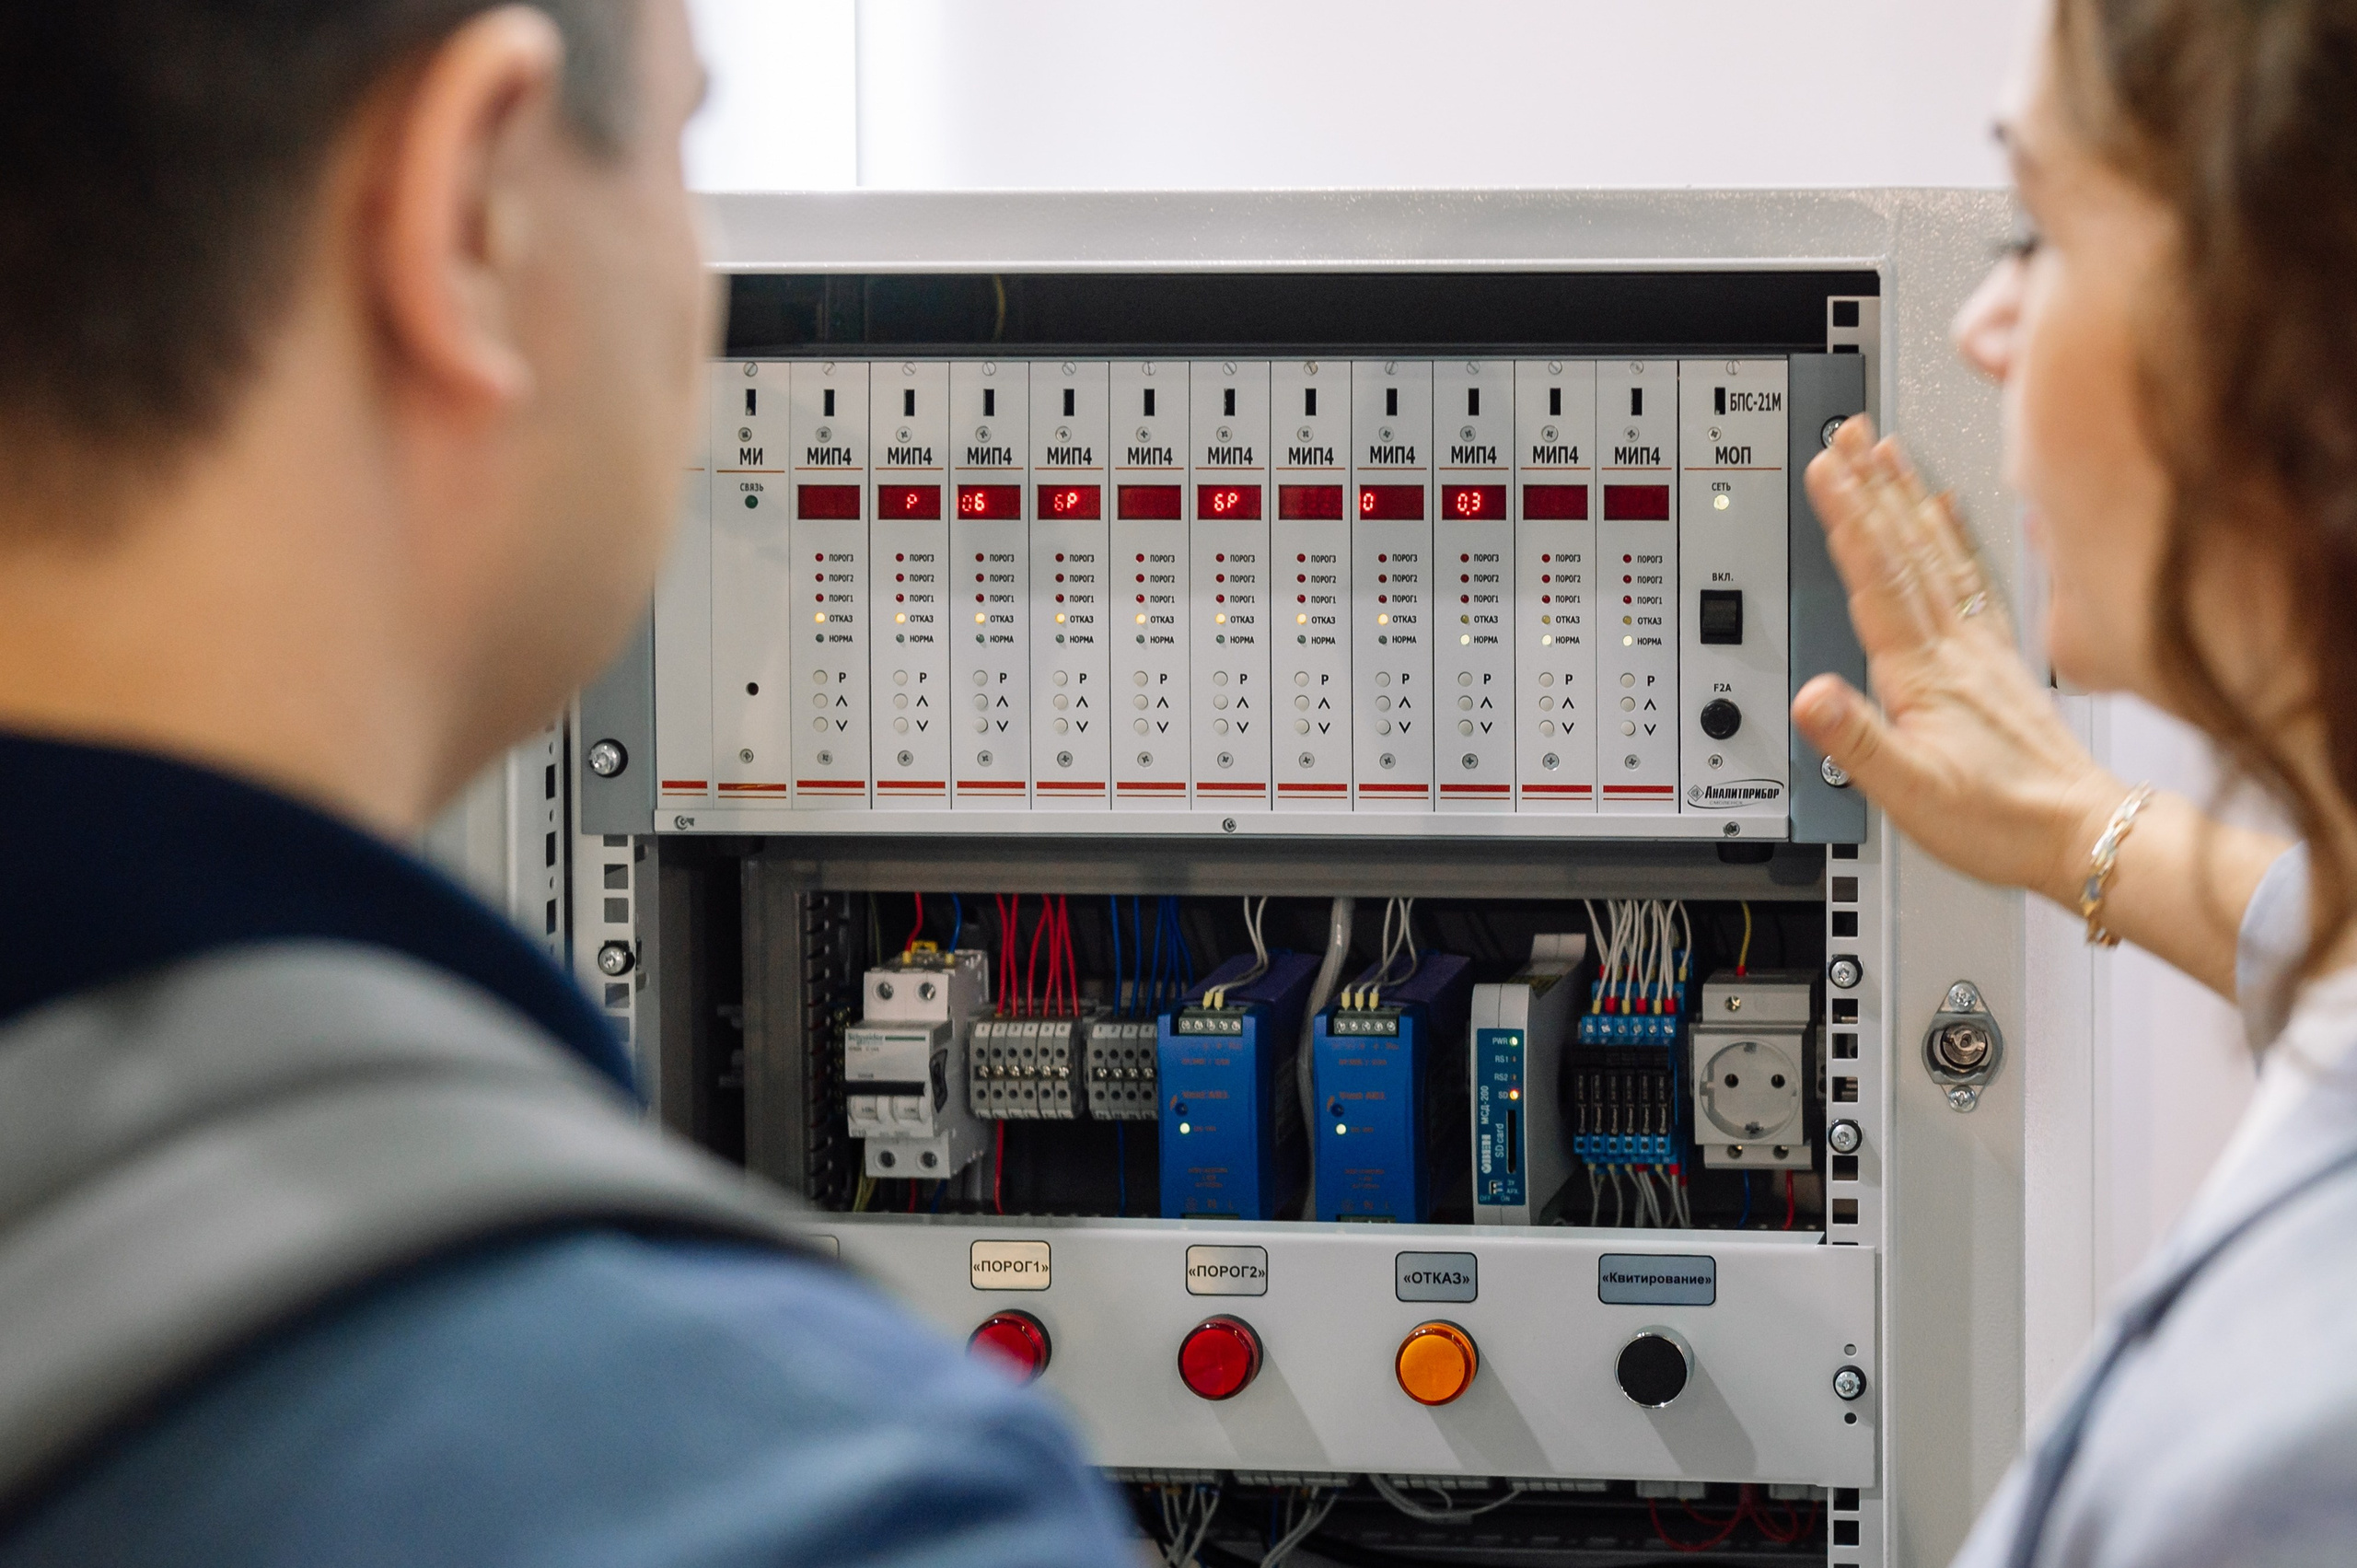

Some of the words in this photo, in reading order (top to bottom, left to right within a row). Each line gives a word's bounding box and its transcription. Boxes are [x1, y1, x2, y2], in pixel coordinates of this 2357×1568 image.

[1729, 391, 1782, 412] БПС-21М
[739, 447, 763, 466] МИ
[807, 447, 853, 466] МИП4
[887, 447, 933, 466] МИП4
[967, 447, 1013, 466] МИП4
[1047, 446, 1093, 466] МИП4
[1127, 447, 1173, 466] МИП4
[1207, 446, 1254, 466] МИП4
[1288, 447, 1335, 466] МИП4
[1369, 445, 1416, 465] МИП4
[1450, 445, 1498, 465] МИП4
[1532, 445, 1579, 465] МИП4
[1614, 446, 1661, 466] МИП4
[1715, 446, 1752, 465] МОП
[739, 482, 764, 493] СВЯЗЬ
[1711, 482, 1732, 492] СЕТЬ
[829, 553, 854, 563] ПОРОГ3
[909, 553, 935, 563] ПОРОГ3
[989, 553, 1015, 563] ПОРОГ3
[1069, 553, 1095, 563] ПОРОГ3
[1149, 553, 1176, 563] ПОРОГ3
[1229, 553, 1256, 563] ПОРОГ3
[1310, 554, 1337, 563] ПОРОГ3
[1391, 553, 1418, 563] ПОРОГ3
[1473, 553, 1500, 563] ПОРОГ3
[1555, 553, 1582, 563] ПОРОГ3
[1637, 554, 1664, 564] ПОРОГ3
[829, 574, 854, 583] ПОРОГ2
[909, 574, 935, 583] ПОРОГ2
[989, 574, 1015, 583] ПОРОГ2
[1069, 574, 1095, 584] ПОРОГ2
[1149, 575, 1176, 584] ПОРОГ2
[1229, 574, 1256, 584] ПОРОГ2
[1310, 575, 1337, 584] ПОРОГ2
[1391, 574, 1418, 583] ПОРОГ2
[1473, 574, 1500, 583] ПОРОГ2
[1555, 574, 1582, 584] ПОРОГ2
[1637, 575, 1663, 585] ПОРОГ2
[1712, 572, 1734, 582] ВКЛ.
[829, 594, 853, 603] ПОРОГ1
[909, 594, 935, 603] ПОРОГ1
[989, 594, 1015, 603] ПОРОГ1
[1069, 594, 1095, 604] ПОРОГ1
[1149, 595, 1176, 604] ПОРОГ1
[1229, 595, 1256, 604] ПОРОГ1
[1310, 595, 1337, 605] ПОРОГ1
[1391, 594, 1418, 603] ПОРОГ1
[1473, 594, 1499, 604] ПОРОГ1
[1555, 595, 1581, 604] ПОРОГ1
[1636, 596, 1663, 605] ПОРОГ1
[829, 614, 853, 623] ОТКАЗ
[909, 614, 935, 623] ОТКАЗ
[989, 614, 1015, 623] ОТКАЗ
[1069, 614, 1095, 624] ОТКАЗ
[1150, 615, 1175, 624] ОТКАЗ
[1229, 615, 1255, 624] ОТКАЗ
[1311, 615, 1336, 625] ОТКАЗ
[1392, 614, 1417, 624] ОТКАЗ
[1473, 615, 1499, 624] ОТКАЗ
[1555, 615, 1581, 624] ОТКАЗ
[1637, 616, 1663, 626] ОТКАЗ
[829, 634, 853, 644] НОРМА
[909, 634, 935, 644] НОРМА
[989, 634, 1015, 644] НОРМА
[1069, 634, 1095, 644] НОРМА
[1150, 635, 1175, 645] НОРМА
[1229, 635, 1255, 645] НОРМА
[1311, 636, 1336, 645] НОРМА
[1391, 635, 1417, 645] НОРМА
[1473, 635, 1499, 645] НОРМА
[1555, 635, 1581, 645] НОРМА
[1637, 637, 1663, 646] НОРМА
[1713, 682, 1732, 692] F2A
[1492, 1037, 1508, 1045] PWR
[1498, 1090, 1508, 1099] SD
[972, 1260, 1049, 1273] «ПОРОГ1»
[1189, 1264, 1266, 1279] «ПОРОГ2»
[1403, 1271, 1470, 1285] «ОТКАЗ»
[1602, 1272, 1713, 1287] «Квитирование»
